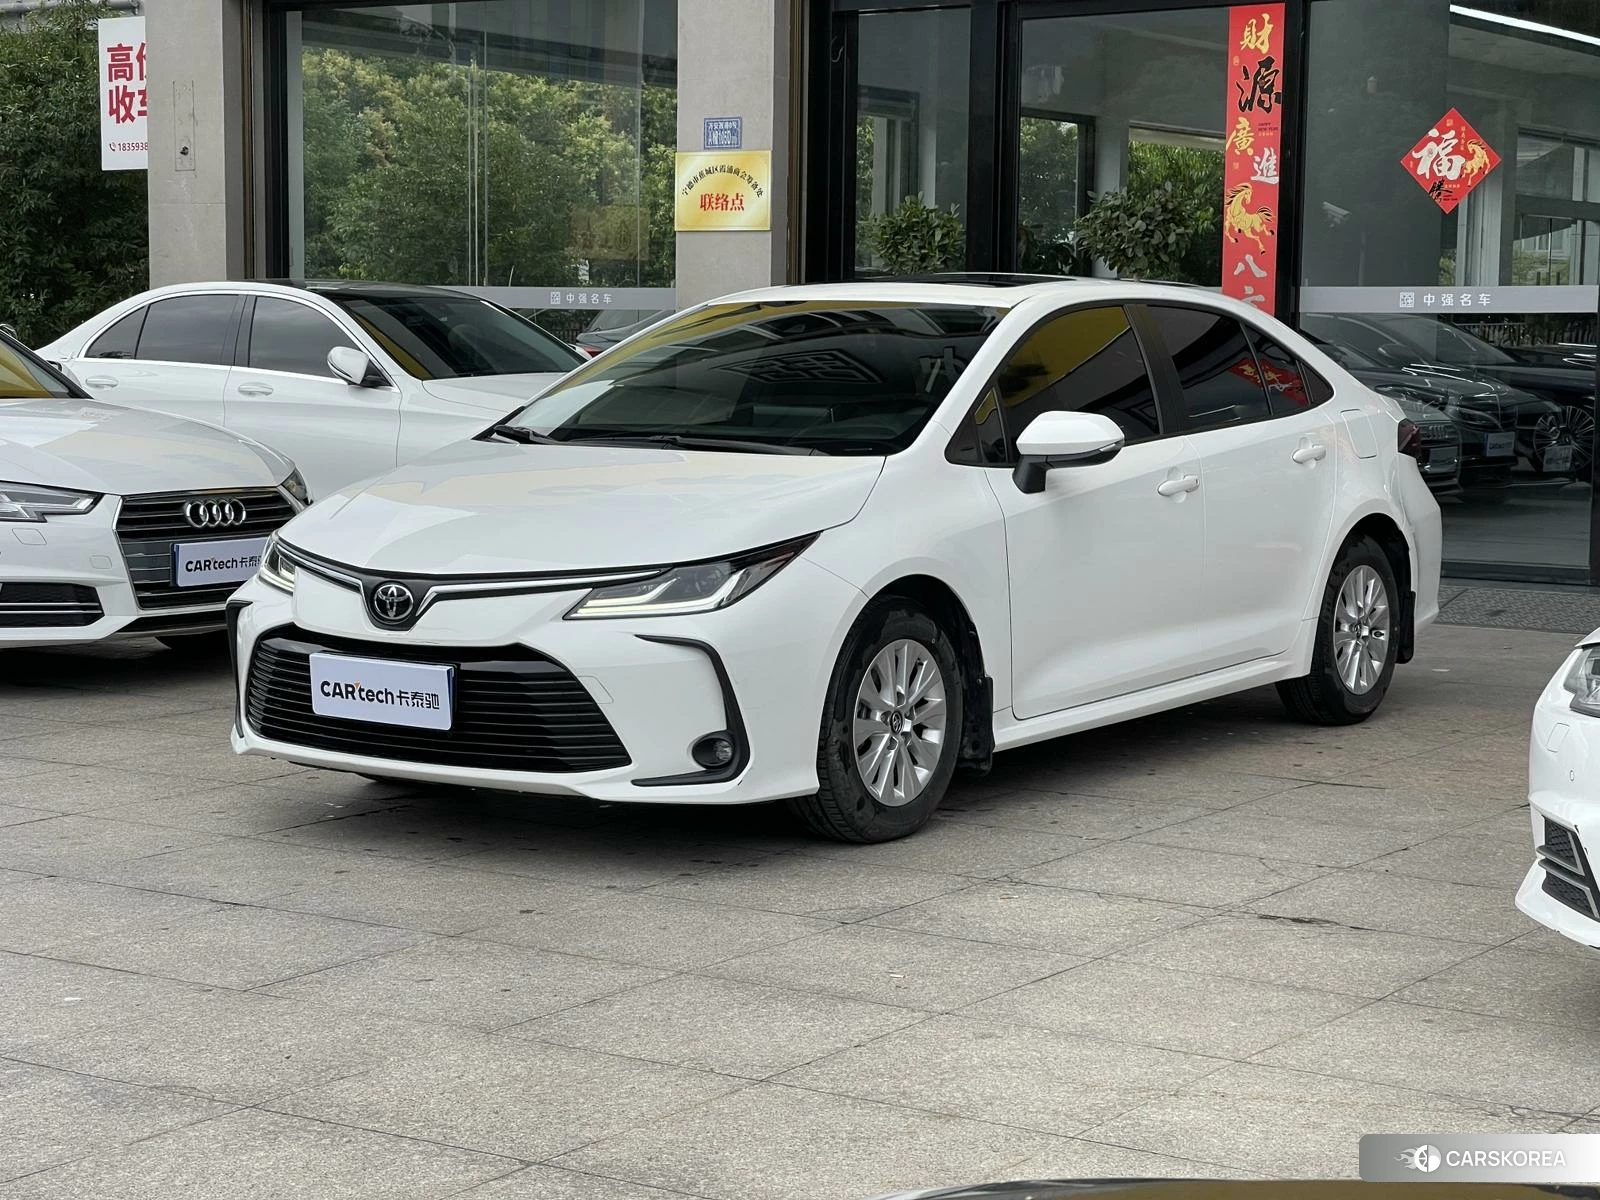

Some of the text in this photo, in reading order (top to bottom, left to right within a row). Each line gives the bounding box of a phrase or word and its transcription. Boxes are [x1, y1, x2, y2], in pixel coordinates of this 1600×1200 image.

[1411, 128, 1466, 181] 福
[700, 192, 745, 211] 联络点
[566, 292, 612, 304] 中强名车
[1423, 292, 1491, 307] 中强名车
